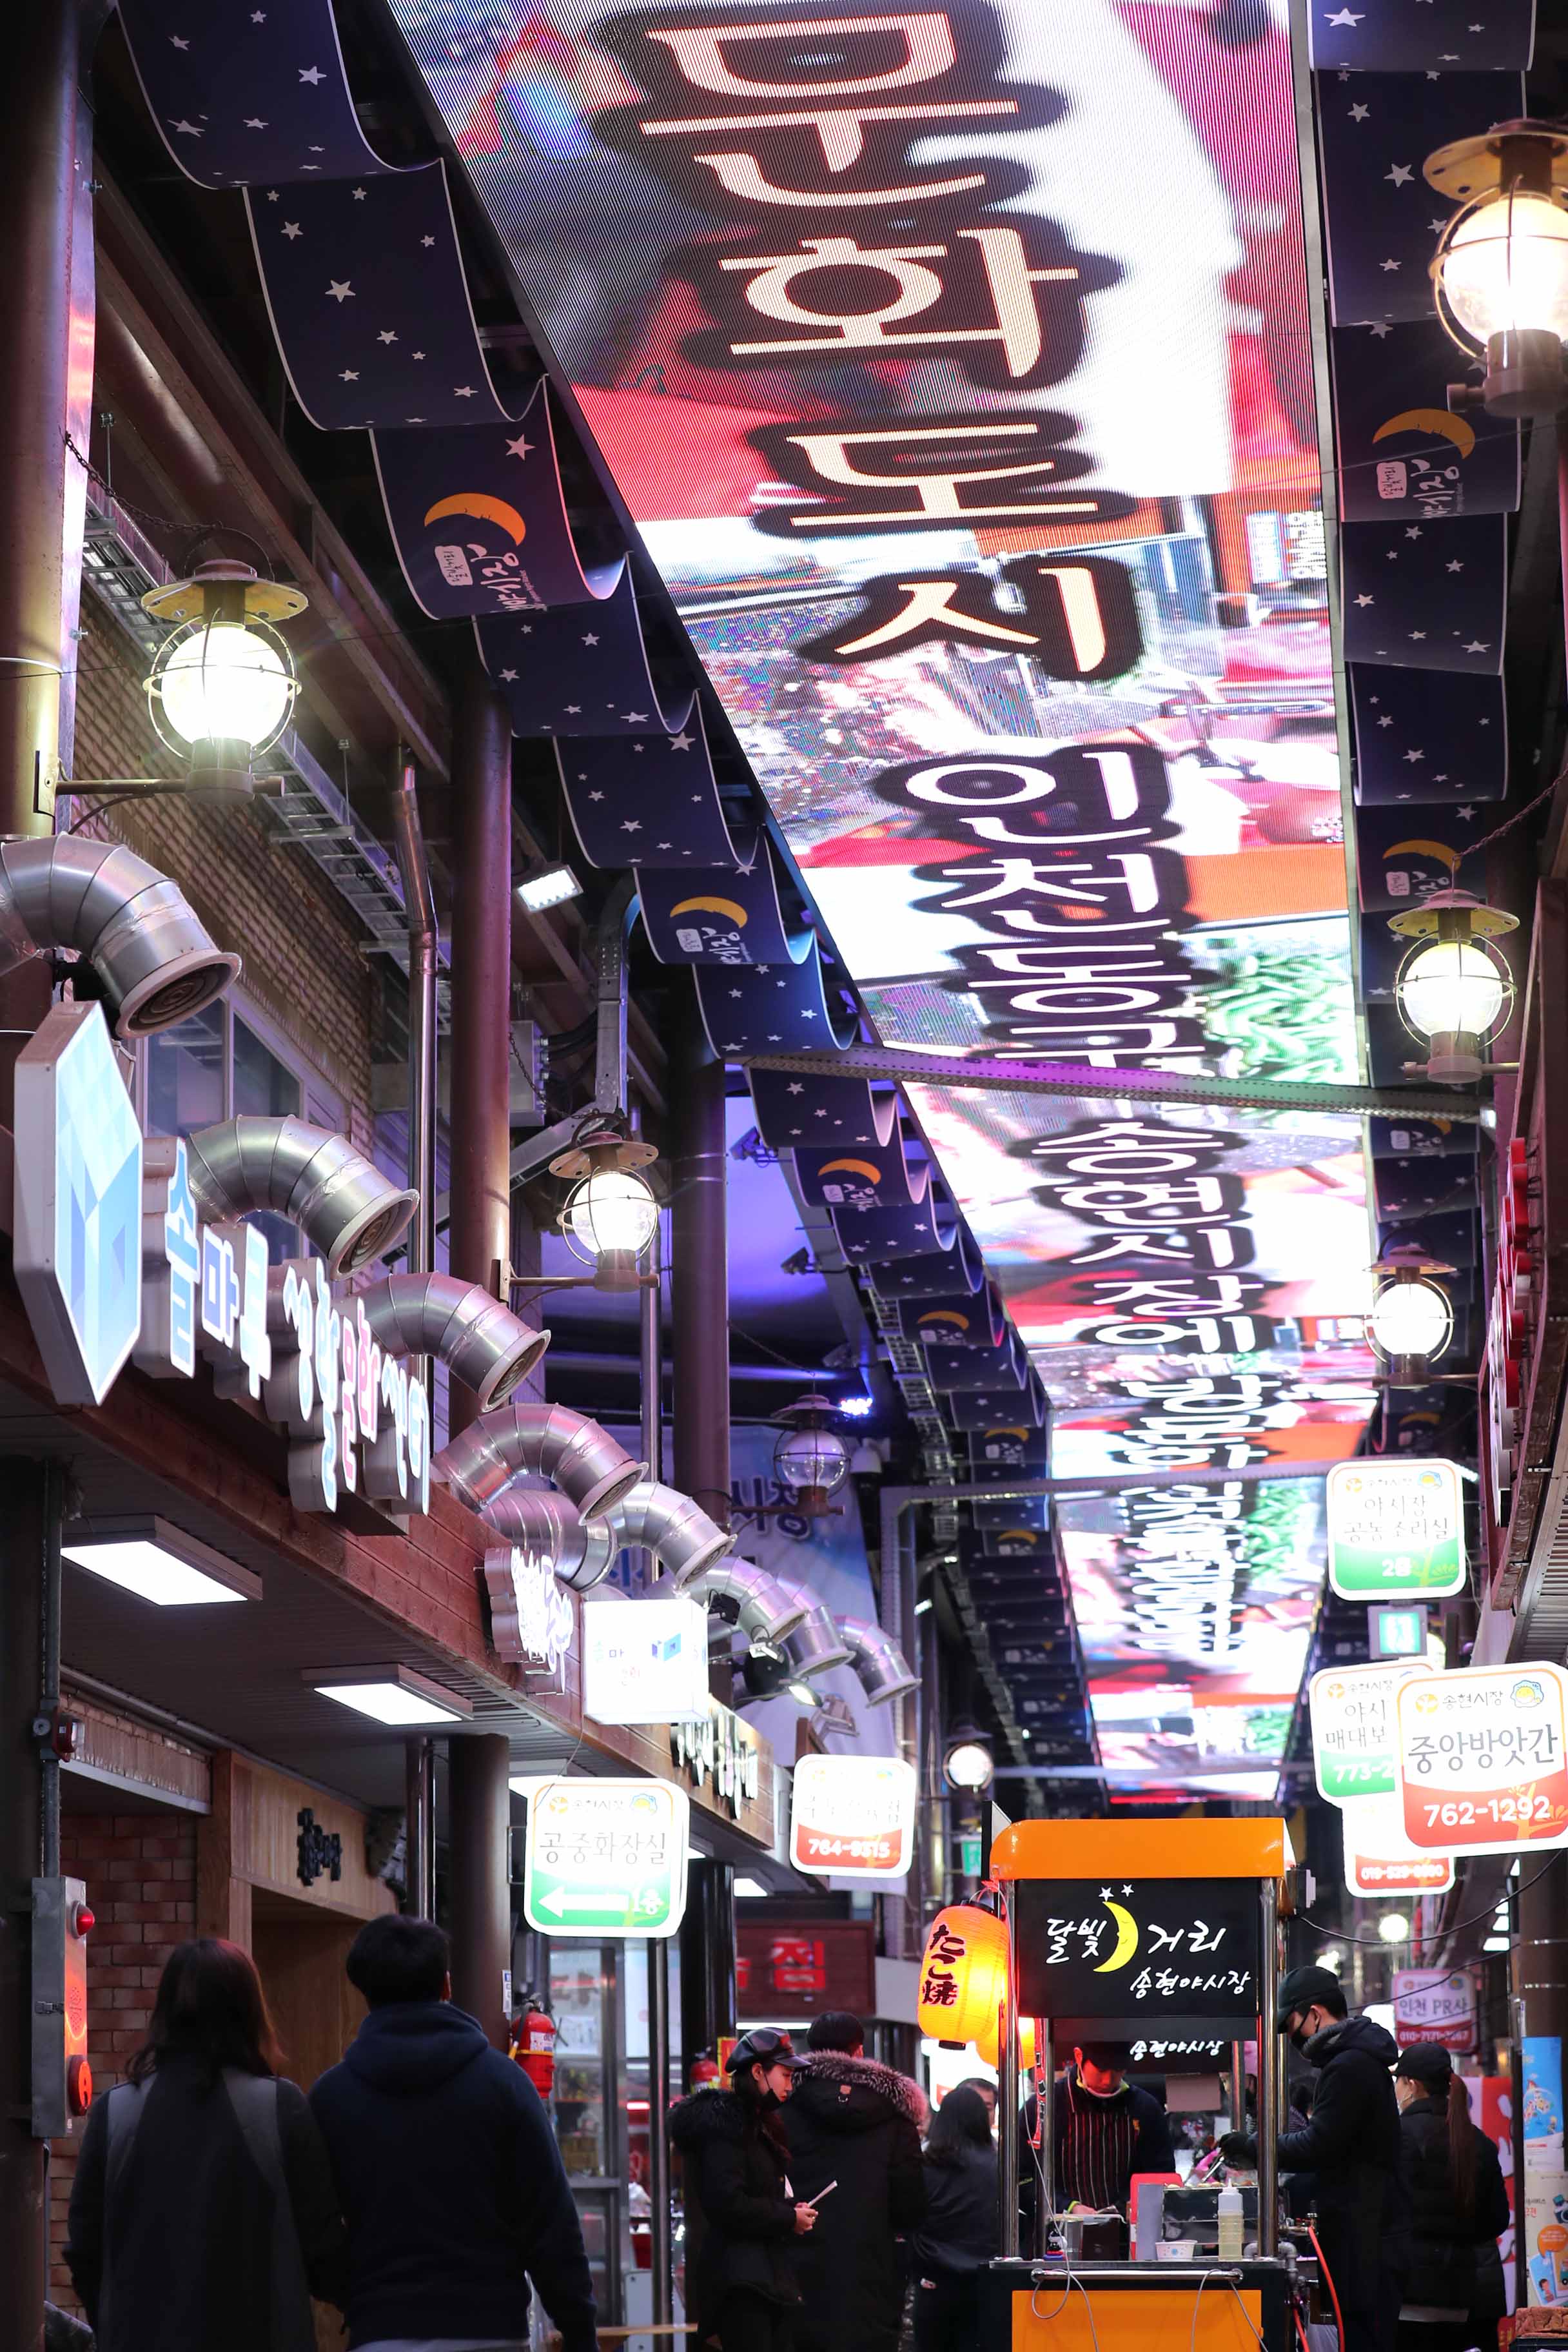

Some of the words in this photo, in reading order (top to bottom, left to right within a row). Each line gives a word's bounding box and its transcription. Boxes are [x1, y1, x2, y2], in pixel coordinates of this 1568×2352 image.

[640, 10, 1108, 674] 문화도시
[901, 749, 1207, 1119] 인천동구
[1031, 1122, 1264, 1353] 송현시장에
[165, 1137, 271, 1400] 솔마루
[1442, 1691, 1504, 1711] 송현시장
[1407, 1723, 1560, 1774] 중앙방앗간
[1423, 1795, 1551, 1828] 762-1292
[538, 1831, 667, 1865] 공중화장실
[922, 1924, 965, 2006] たこ焼
[1046, 1917, 1108, 1964] 달빛
[1147, 1919, 1227, 1954] 거리
[1129, 1966, 1252, 1999] 송현야시장
